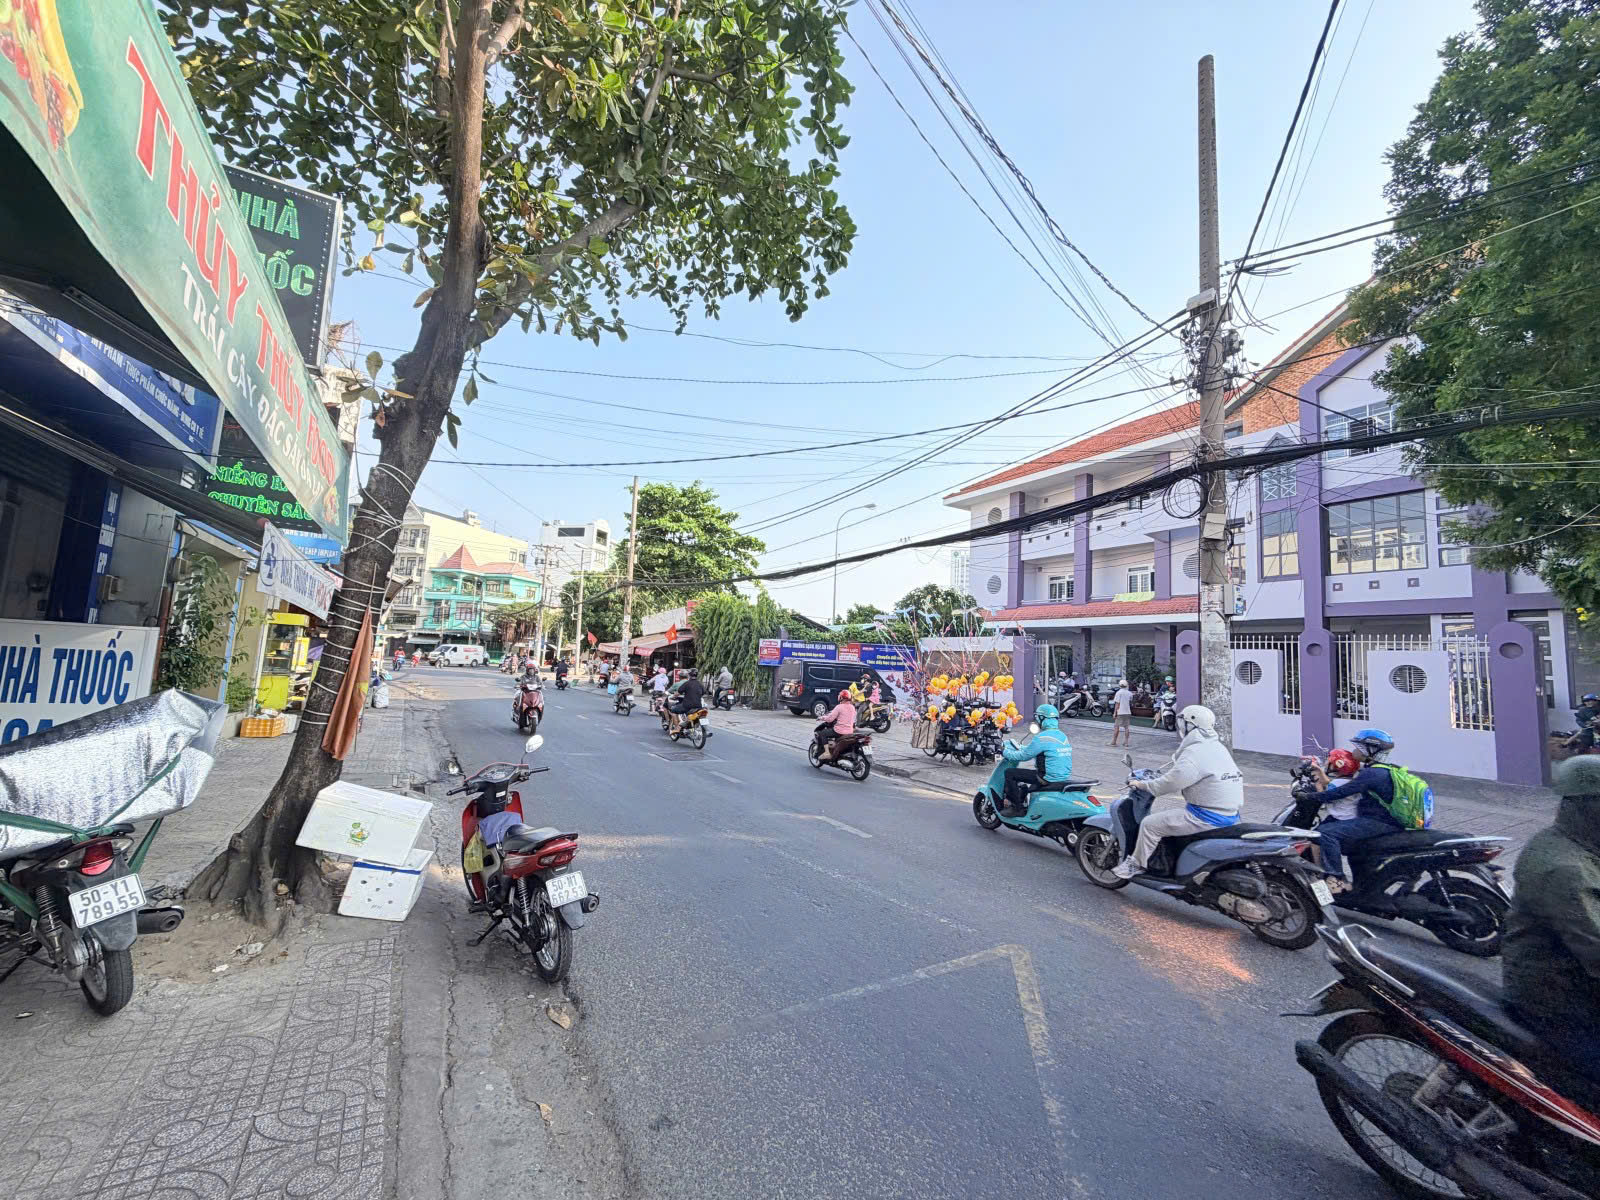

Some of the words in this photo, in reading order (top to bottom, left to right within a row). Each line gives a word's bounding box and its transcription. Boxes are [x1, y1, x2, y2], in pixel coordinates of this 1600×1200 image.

[181, 261, 225, 361] TRÁI
[227, 348, 257, 408] CÂY
[48, 630, 134, 705] THUỐC
[79, 891, 140, 925] 789.55
[80, 880, 130, 907] 50-Y1
